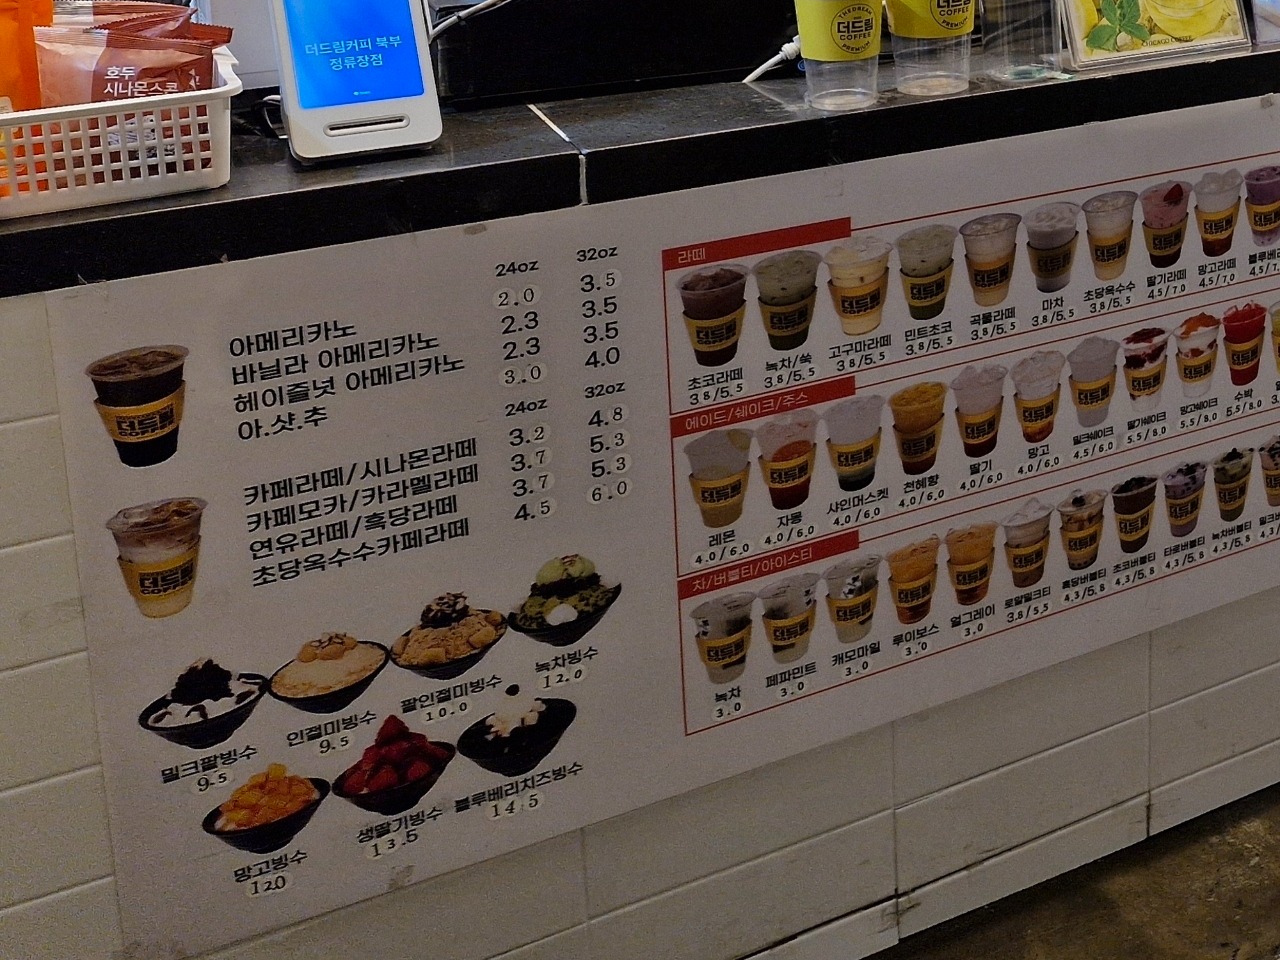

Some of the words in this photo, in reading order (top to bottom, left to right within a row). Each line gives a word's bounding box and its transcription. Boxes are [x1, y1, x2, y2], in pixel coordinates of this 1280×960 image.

[837, 18, 873, 34] 더드림
[939, 6, 969, 16] COFFEE
[305, 38, 372, 56] 더드림커피
[376, 35, 401, 50] 북부
[330, 54, 383, 70] 정류장점
[104, 66, 135, 80] 호두
[495, 259, 539, 277] 24oz
[576, 246, 618, 262] 32oz
[678, 248, 706, 263] 라떼
[498, 287, 536, 308] 2.0
[580, 272, 617, 293] 3.5
[501, 311, 539, 335] 2.3
[582, 296, 618, 318] 3.5
[229, 319, 357, 357] 아메리카노
[503, 337, 541, 360] 2.3
[583, 322, 619, 343] 3.5
[829, 334, 892, 359] 고구마라떼
[232, 354, 309, 386] 바닐라
[319, 332, 439, 369] 아메리카노
[584, 347, 620, 369] 4.0
[234, 378, 336, 414] 헤이즐넛
[346, 353, 465, 392] 아메리카노
[238, 405, 328, 441] 아.샷.추
[686, 391, 808, 430] 에이드/쉐이크/주스
[244, 438, 477, 506] 카페라떼/시나몬라떼
[247, 464, 480, 533] 카페모카/카라멜라떼
[249, 494, 458, 561] 연유라떼/흑당라떼
[709, 530, 736, 548] 레몬
[252, 517, 469, 588] 초당옥수수카페라떼
[534, 646, 598, 675] 녹차빙수
[766, 662, 817, 688] 페파민트
[287, 710, 377, 747] 인절미빙수
[234, 849, 308, 883] 망고빙수
